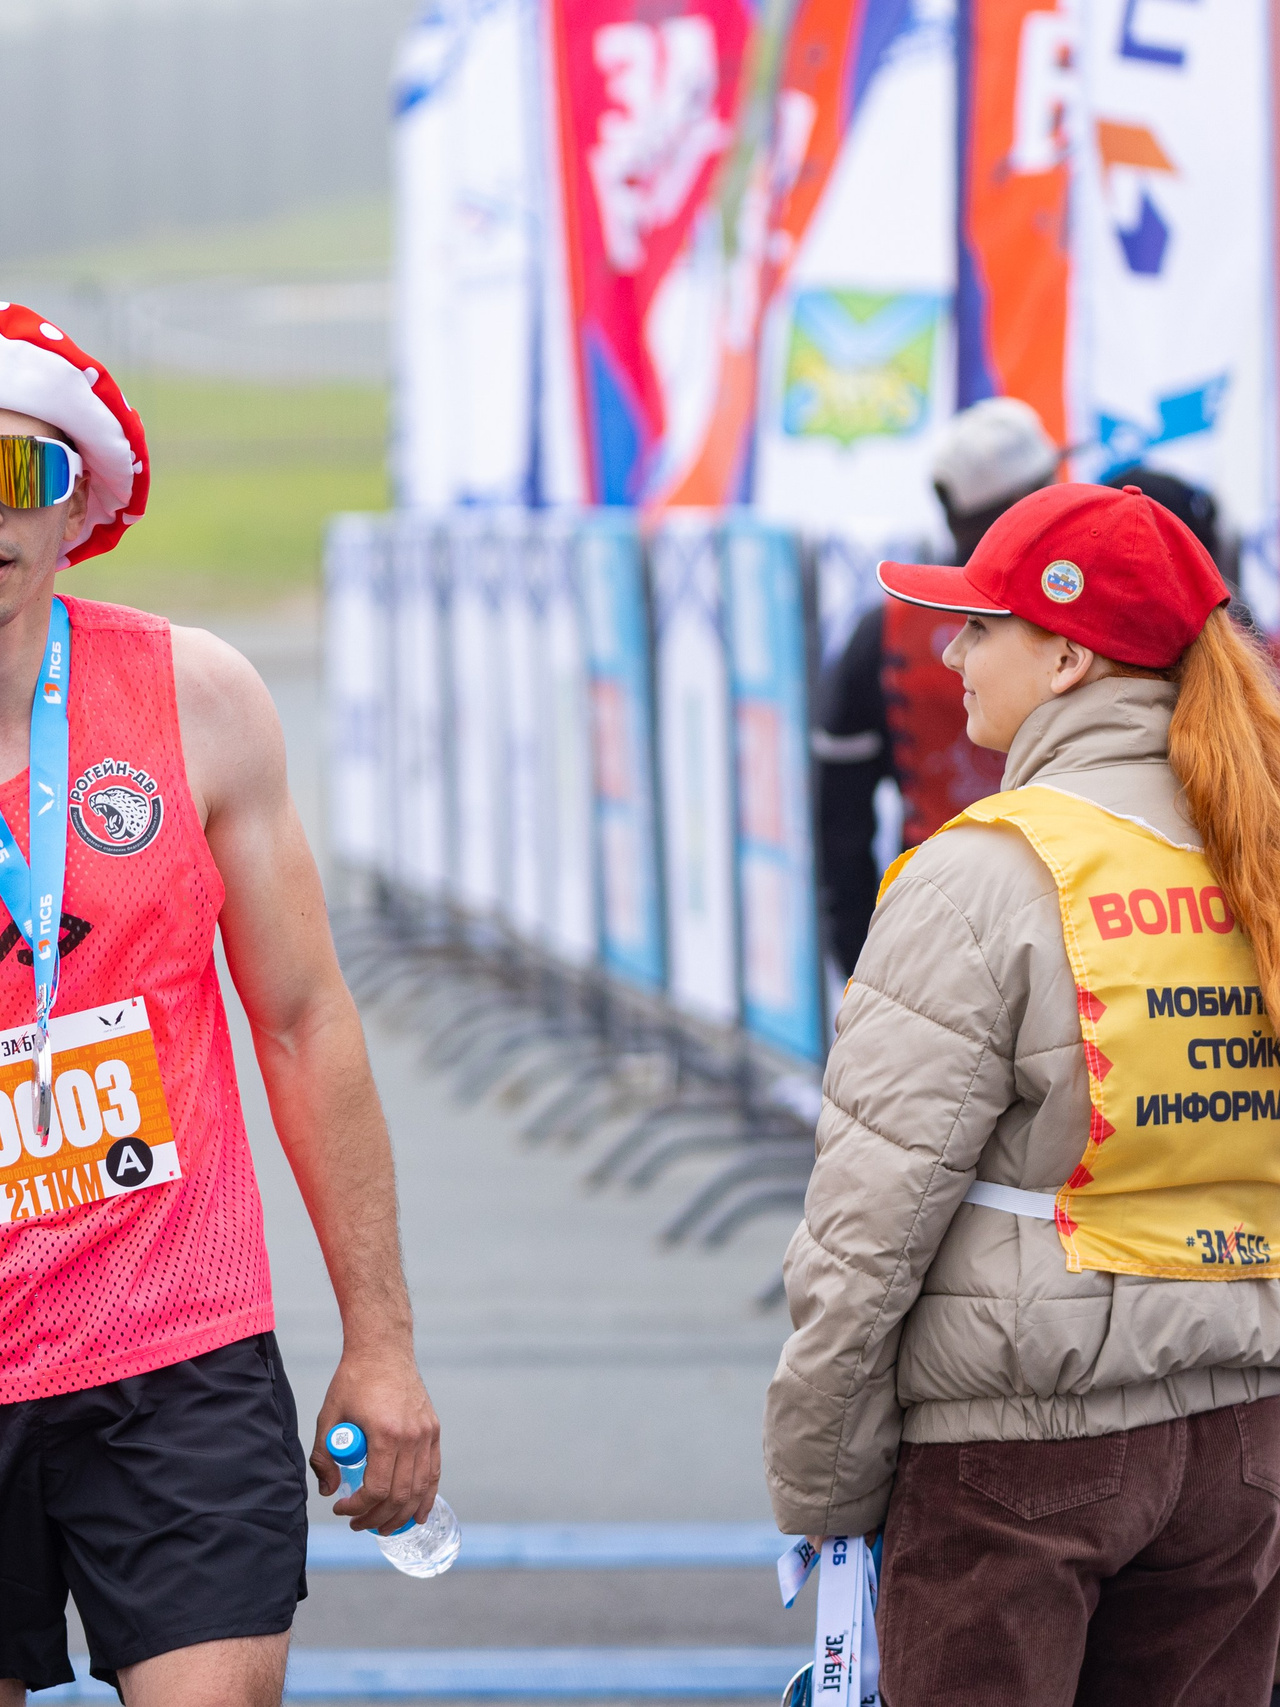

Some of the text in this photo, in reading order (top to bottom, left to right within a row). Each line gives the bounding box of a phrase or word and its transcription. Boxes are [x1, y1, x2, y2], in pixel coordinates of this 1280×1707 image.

[49, 641, 62, 679] ПСБ
[70, 759, 156, 801] РОГЕЙН-ДВ
[40, 894, 52, 935] ПСБ
[1088, 886, 1235, 941] ВОЛО
[116, 1145, 147, 1177] А
